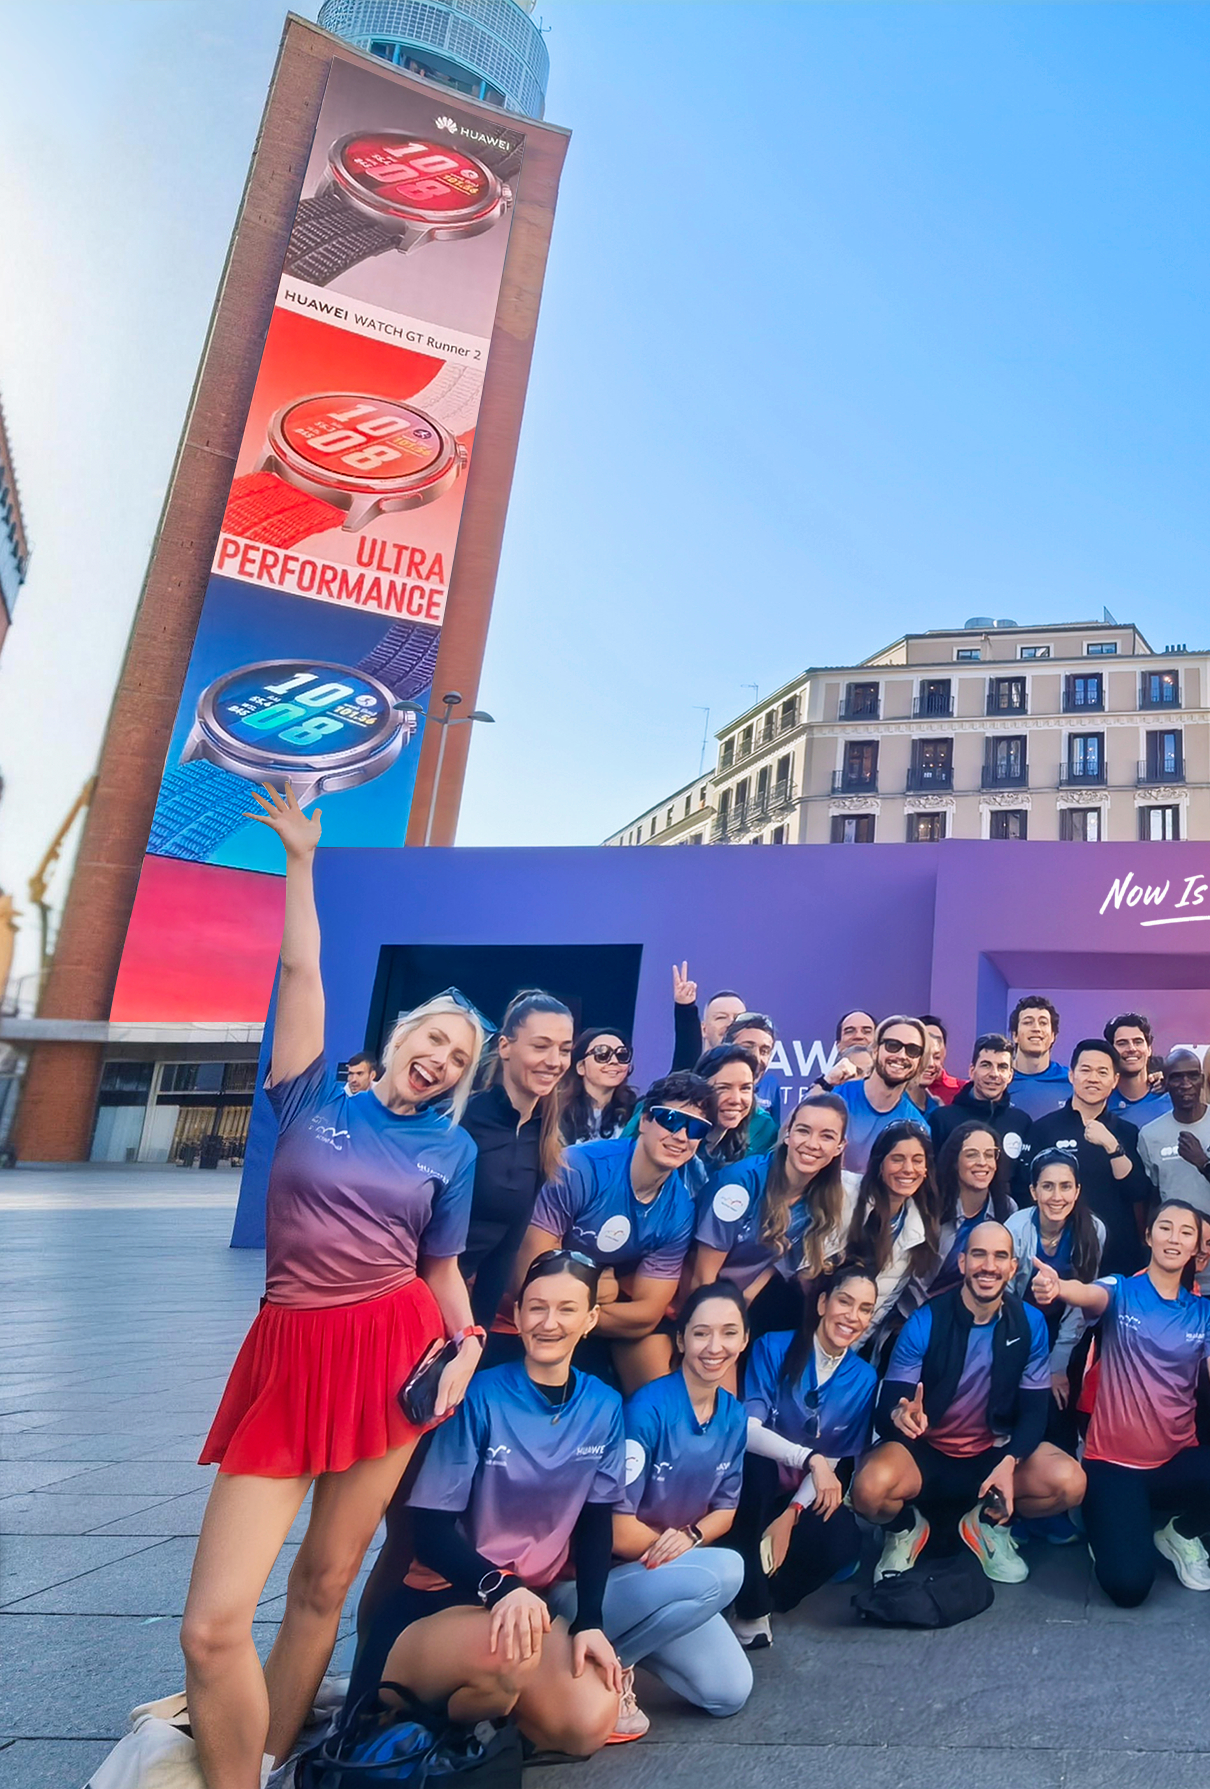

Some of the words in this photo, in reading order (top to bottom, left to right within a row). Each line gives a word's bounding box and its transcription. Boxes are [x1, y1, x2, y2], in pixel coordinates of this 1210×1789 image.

[460, 127, 510, 151] HUAWEI
[284, 289, 350, 321] HUAWEI
[354, 313, 403, 339] WATCH
[406, 330, 424, 345] GT
[427, 336, 471, 359] Runner
[473, 349, 482, 361] 2
[216, 537, 445, 621] PERFORMANCE
[356, 535, 446, 585] ULTRA
[1099, 872, 1170, 915] Now
[1174, 874, 1208, 908] Is
